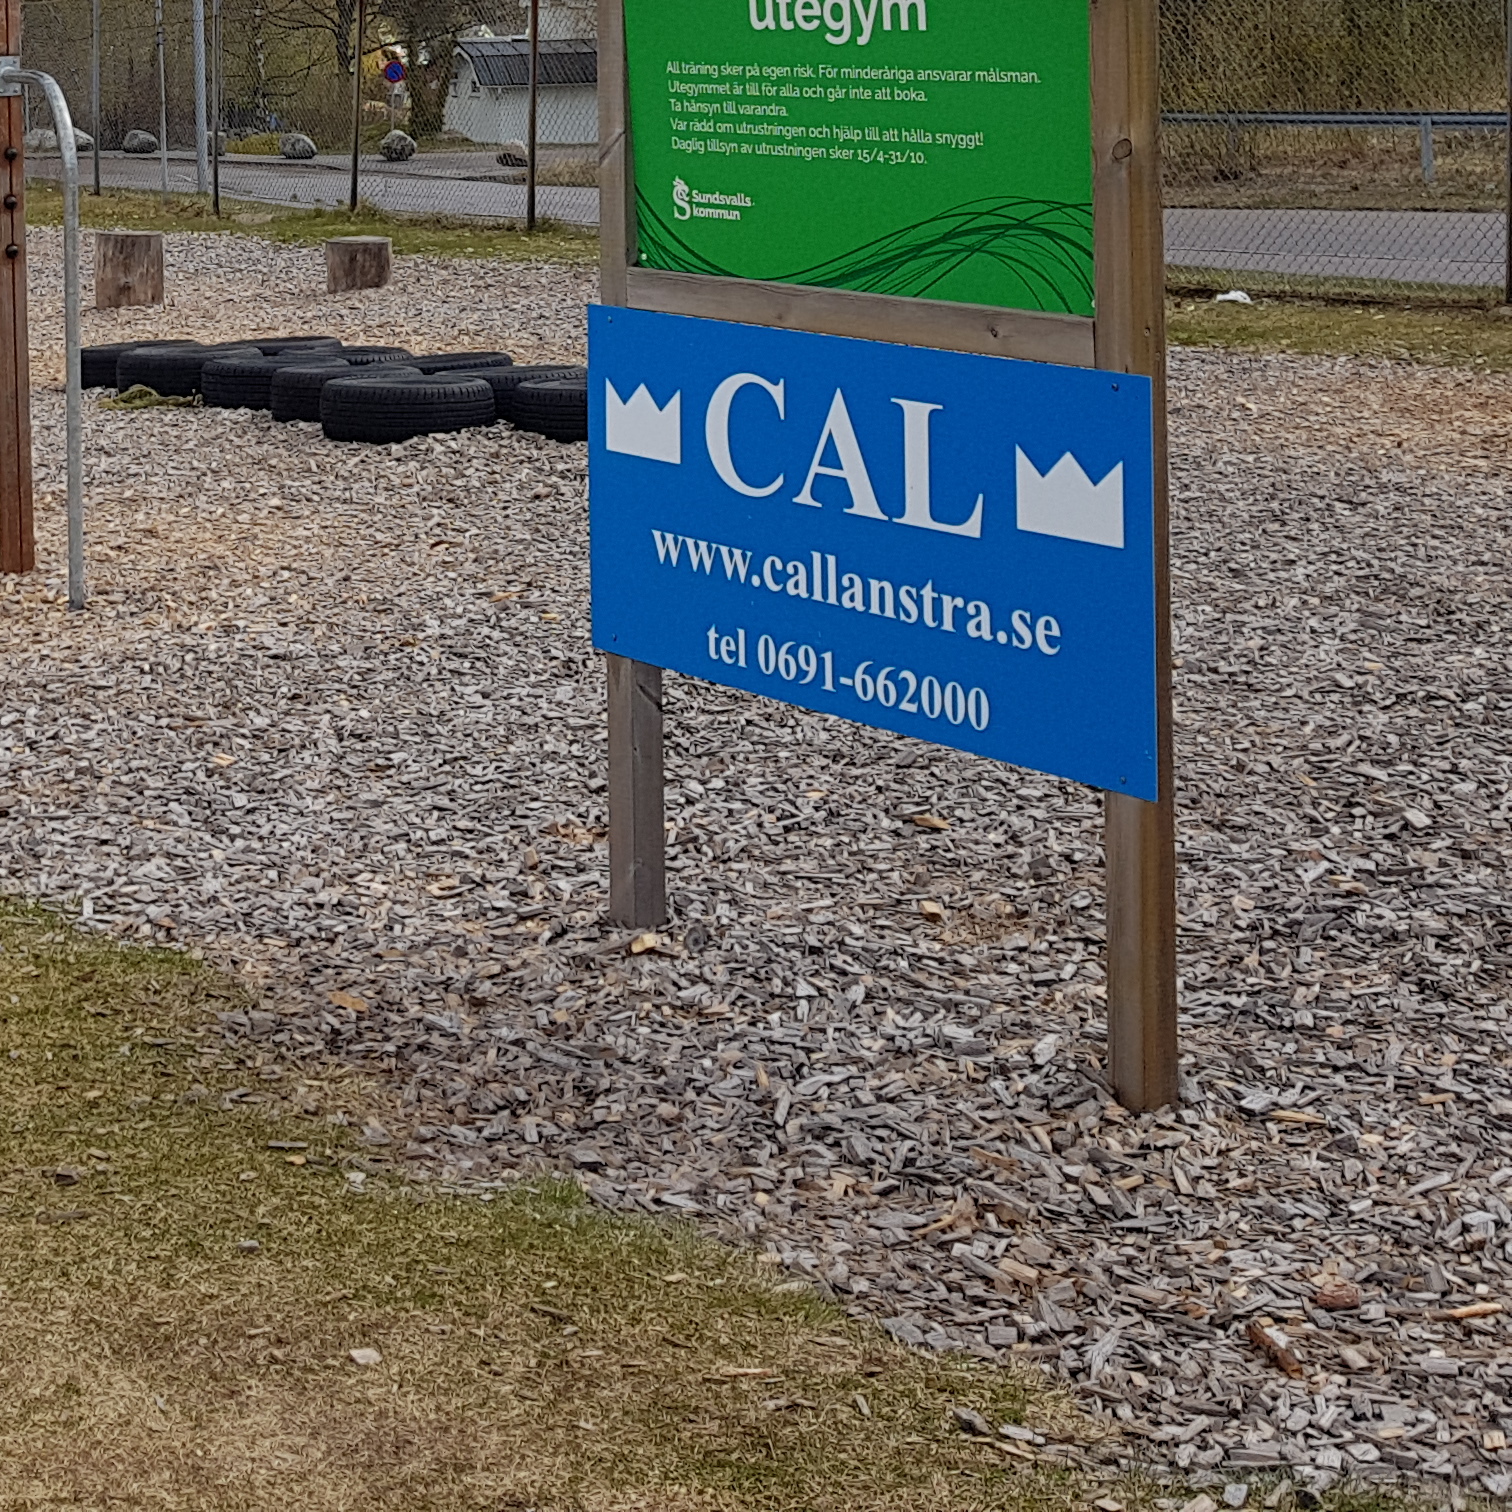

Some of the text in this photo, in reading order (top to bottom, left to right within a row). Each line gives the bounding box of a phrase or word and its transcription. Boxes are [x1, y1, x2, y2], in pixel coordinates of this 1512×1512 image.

[666, 61, 1041, 83] All träning sker på egen risk. För minderåriga ansvarar målsman.
[668, 80, 927, 102] Utegymmet är till för alla och går inte att boka.
[669, 99, 788, 116] Ta hänsyn till varandra.
[670, 118, 984, 149] Var rädd om utrustningen och hjälp till att hålla snyggt!
[672, 137, 927, 164] Daglig tillsyn av utrustningen sker 15/4-31/10.
[692, 190, 752, 207] Sundsvalls
[693, 204, 741, 220] kommun
[704, 372, 984, 538] CAL
[651, 529, 1062, 656] www.callanstra.se
[706, 625, 990, 731] tel 0691-662000
